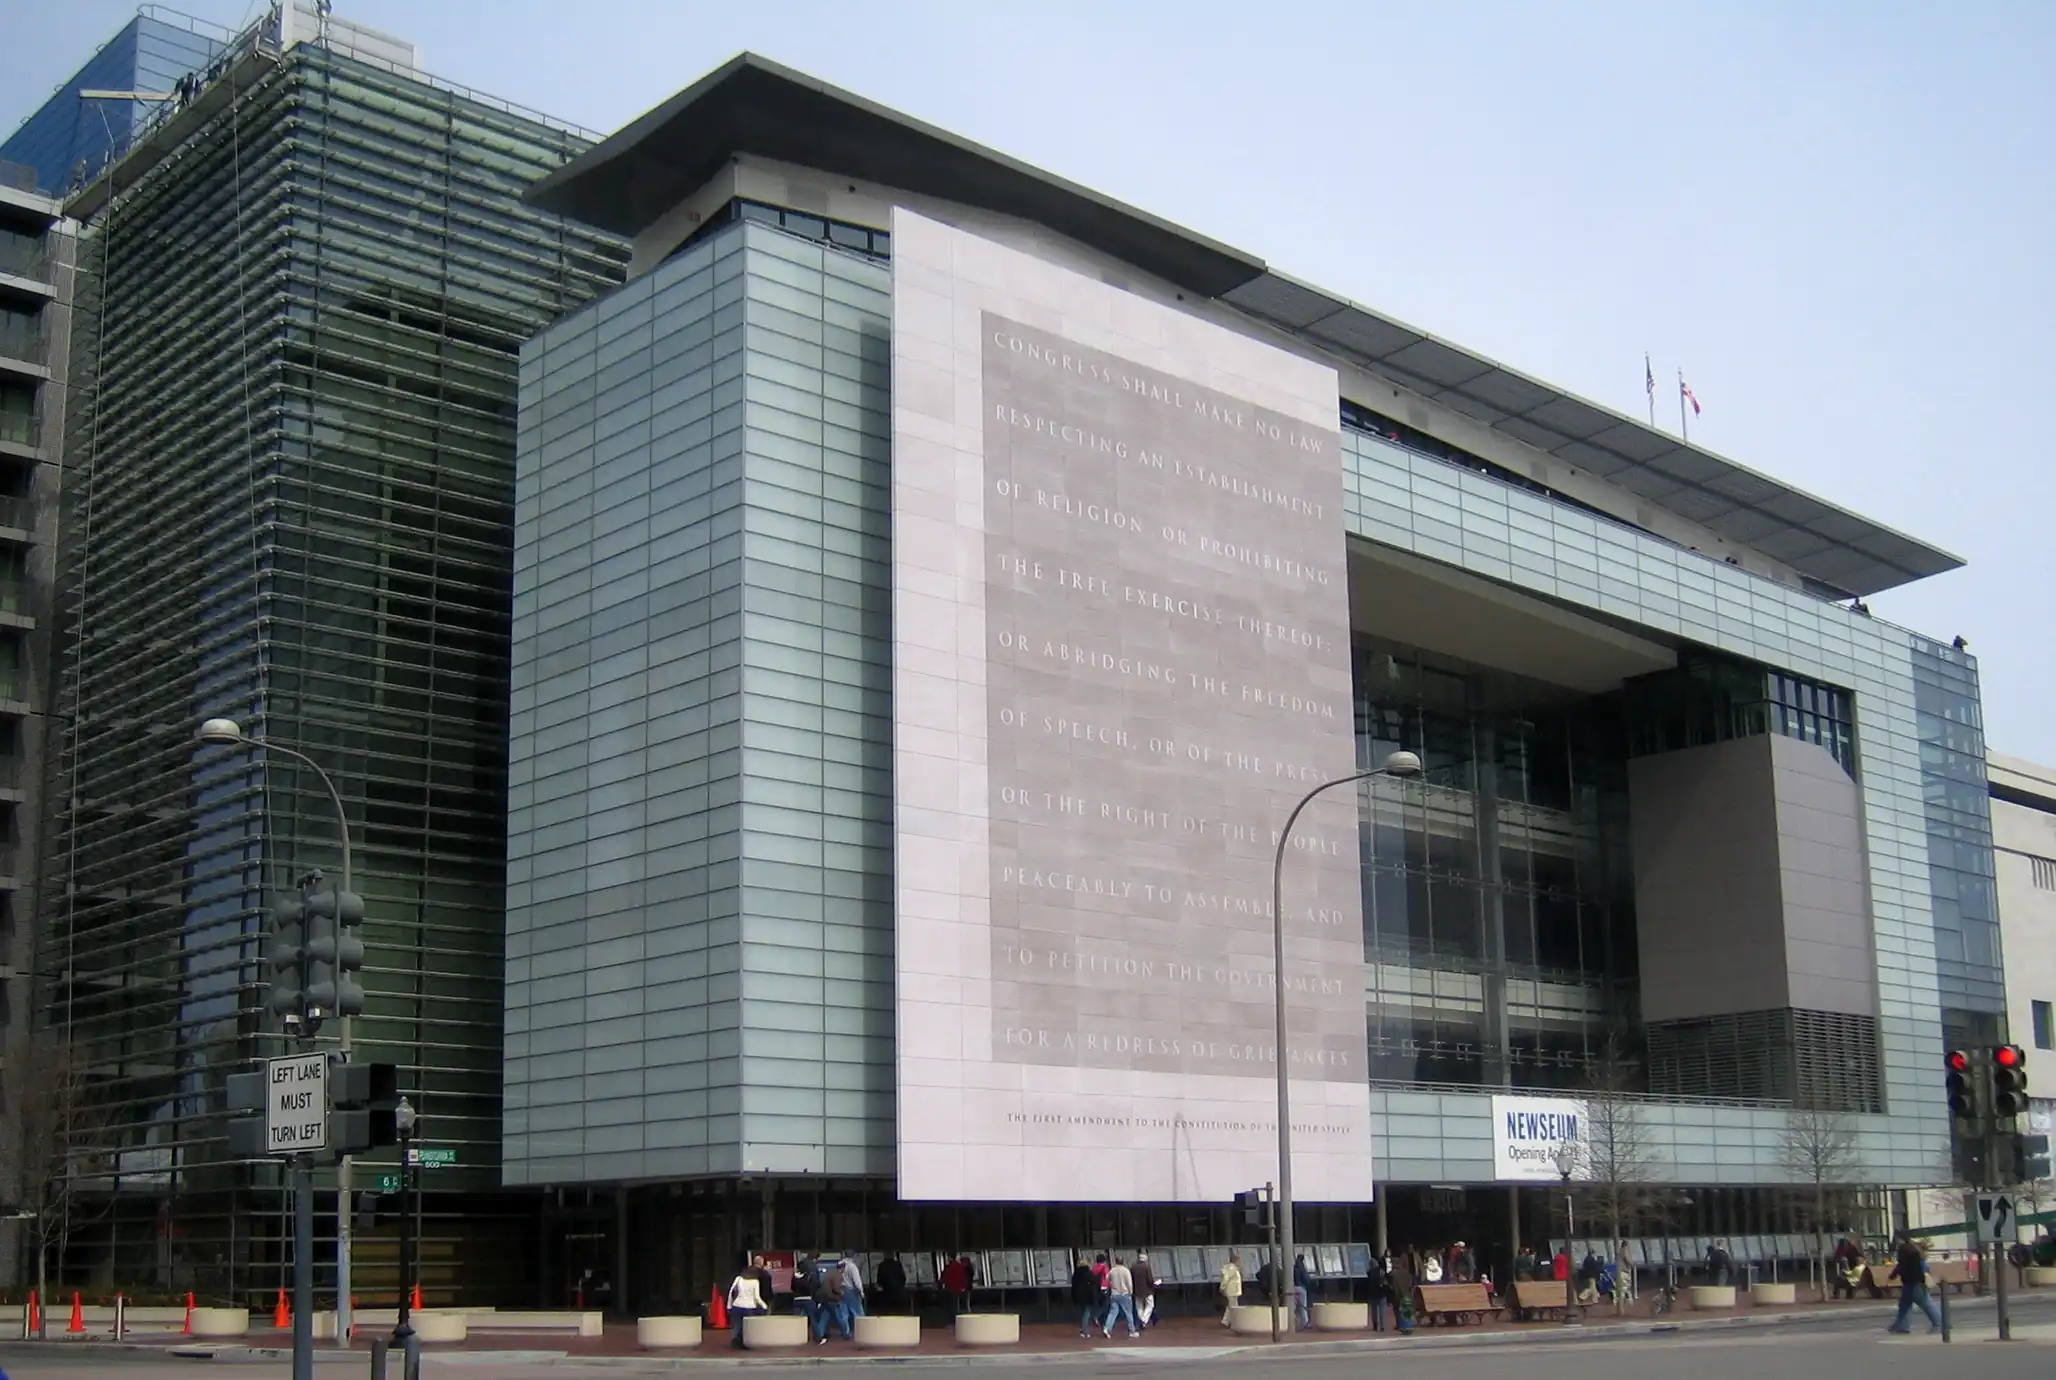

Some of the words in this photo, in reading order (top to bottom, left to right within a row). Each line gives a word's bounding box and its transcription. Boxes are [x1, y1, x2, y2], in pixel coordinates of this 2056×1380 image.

[994, 332, 1110, 383] CONGRESS
[1123, 375, 1183, 408] SHALL
[1194, 400, 1243, 428] MAKE
[1256, 420, 1280, 441] NO
[1290, 430, 1323, 454] LAW
[996, 404, 1127, 459] RESPECTING
[1138, 450, 1163, 469] AN
[1175, 461, 1323, 520] ESTABLISHMENT
[997, 479, 1022, 499] OF
[1162, 526, 1188, 546] OR
[1200, 536, 1328, 585] PROHIBITING
[998, 554, 1044, 580] THE
[1059, 568, 1110, 596] FREE
[1125, 586, 1223, 625] EXERCISE
[999, 631, 1029, 652] OR
[1044, 641, 1176, 684] ABRIDGING
[1190, 672, 1230, 696] THE
[1241, 684, 1333, 718] FREEDOM
[1000, 708, 1029, 727] OF
[1150, 738, 1175, 756] OR
[1188, 745, 1212, 763] OF
[1225, 751, 1262, 773] THE
[1002, 787, 1032, 806] OR
[1044, 793, 1085, 816] THE
[1101, 802, 1170, 829] RIGHT
[1184, 817, 1207, 835] OF
[1220, 822, 1257, 842] THE
[1271, 830, 1338, 856] POPLE
[1004, 866, 1132, 898] PEACEABLY
[1144, 884, 1172, 904] TO
[1307, 907, 1343, 926] AND
[1004, 946, 1032, 965] TO
[1049, 951, 1153, 978] PETITION
[1166, 963, 1203, 982] THE
[1215, 968, 1343, 995] GOVERNMENT
[272, 1067, 294, 1084] LEFT
[297, 1063, 321, 1081] LANE
[1006, 1027, 1049, 1048] FOR
[1063, 1032, 1075, 1049] A
[1087, 1033, 1180, 1055] REDRESS
[1192, 1041, 1217, 1059] OF
[1229, 1045, 1348, 1067] GRIEANCES
[281, 1092, 312, 1111] MUST
[1008, 1113, 1027, 1123] THE
[1033, 1114, 1062, 1124] FIRST
[1067, 1116, 1130, 1127] AMENDMENT
[1136, 1118, 1148, 1127] TO
[1153, 1119, 1169, 1128] THE
[1174, 1119, 1246, 1130] CONSTITUTION
[1507, 1111, 1578, 1141] NEWSEUM
[271, 1126, 296, 1143] TURN
[299, 1123, 322, 1140] LEFT
[1508, 1144, 1546, 1163] Opening
